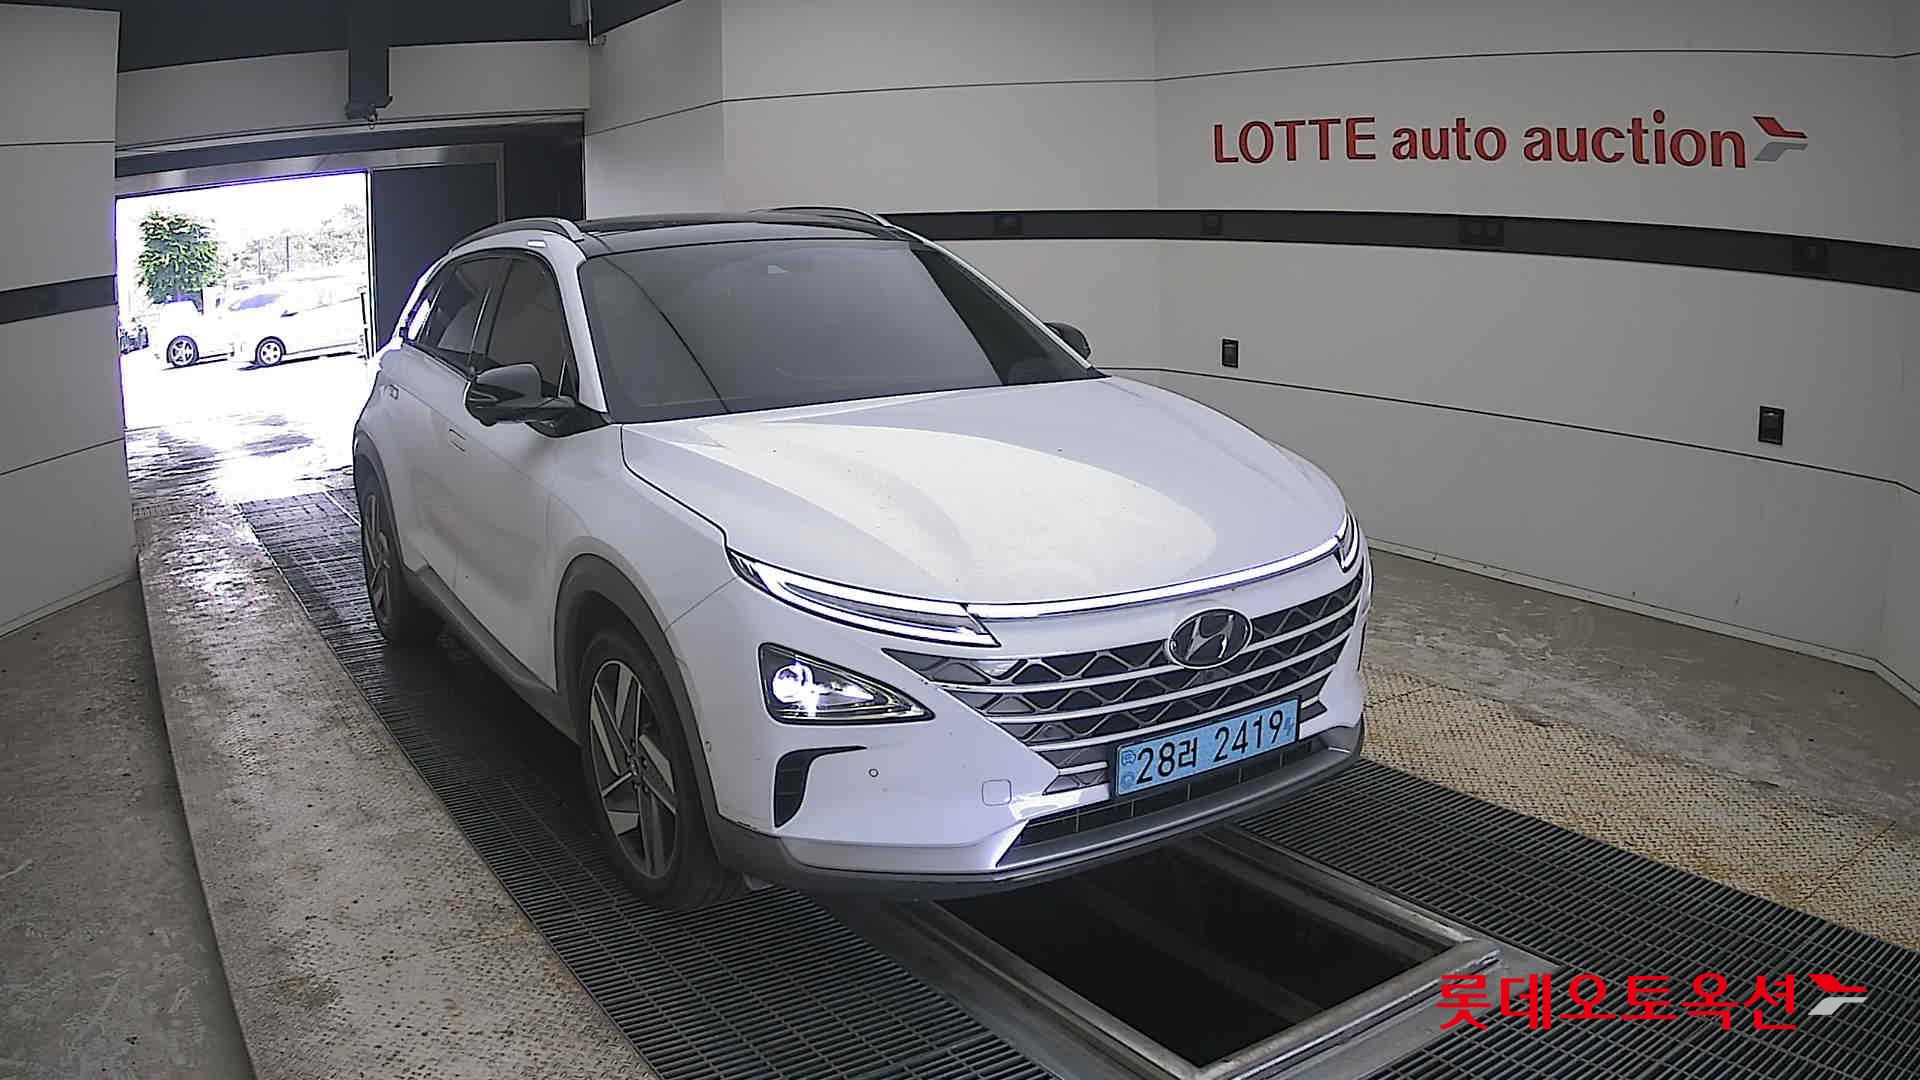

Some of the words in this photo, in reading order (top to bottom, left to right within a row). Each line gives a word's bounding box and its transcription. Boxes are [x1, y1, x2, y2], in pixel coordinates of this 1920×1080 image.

[1214, 116, 1377, 164] LOTTE
[1392, 117, 1507, 161] auto
[1522, 109, 1746, 169] auction
[1136, 736, 1199, 785] 28러
[1213, 710, 1284, 763] 2419
